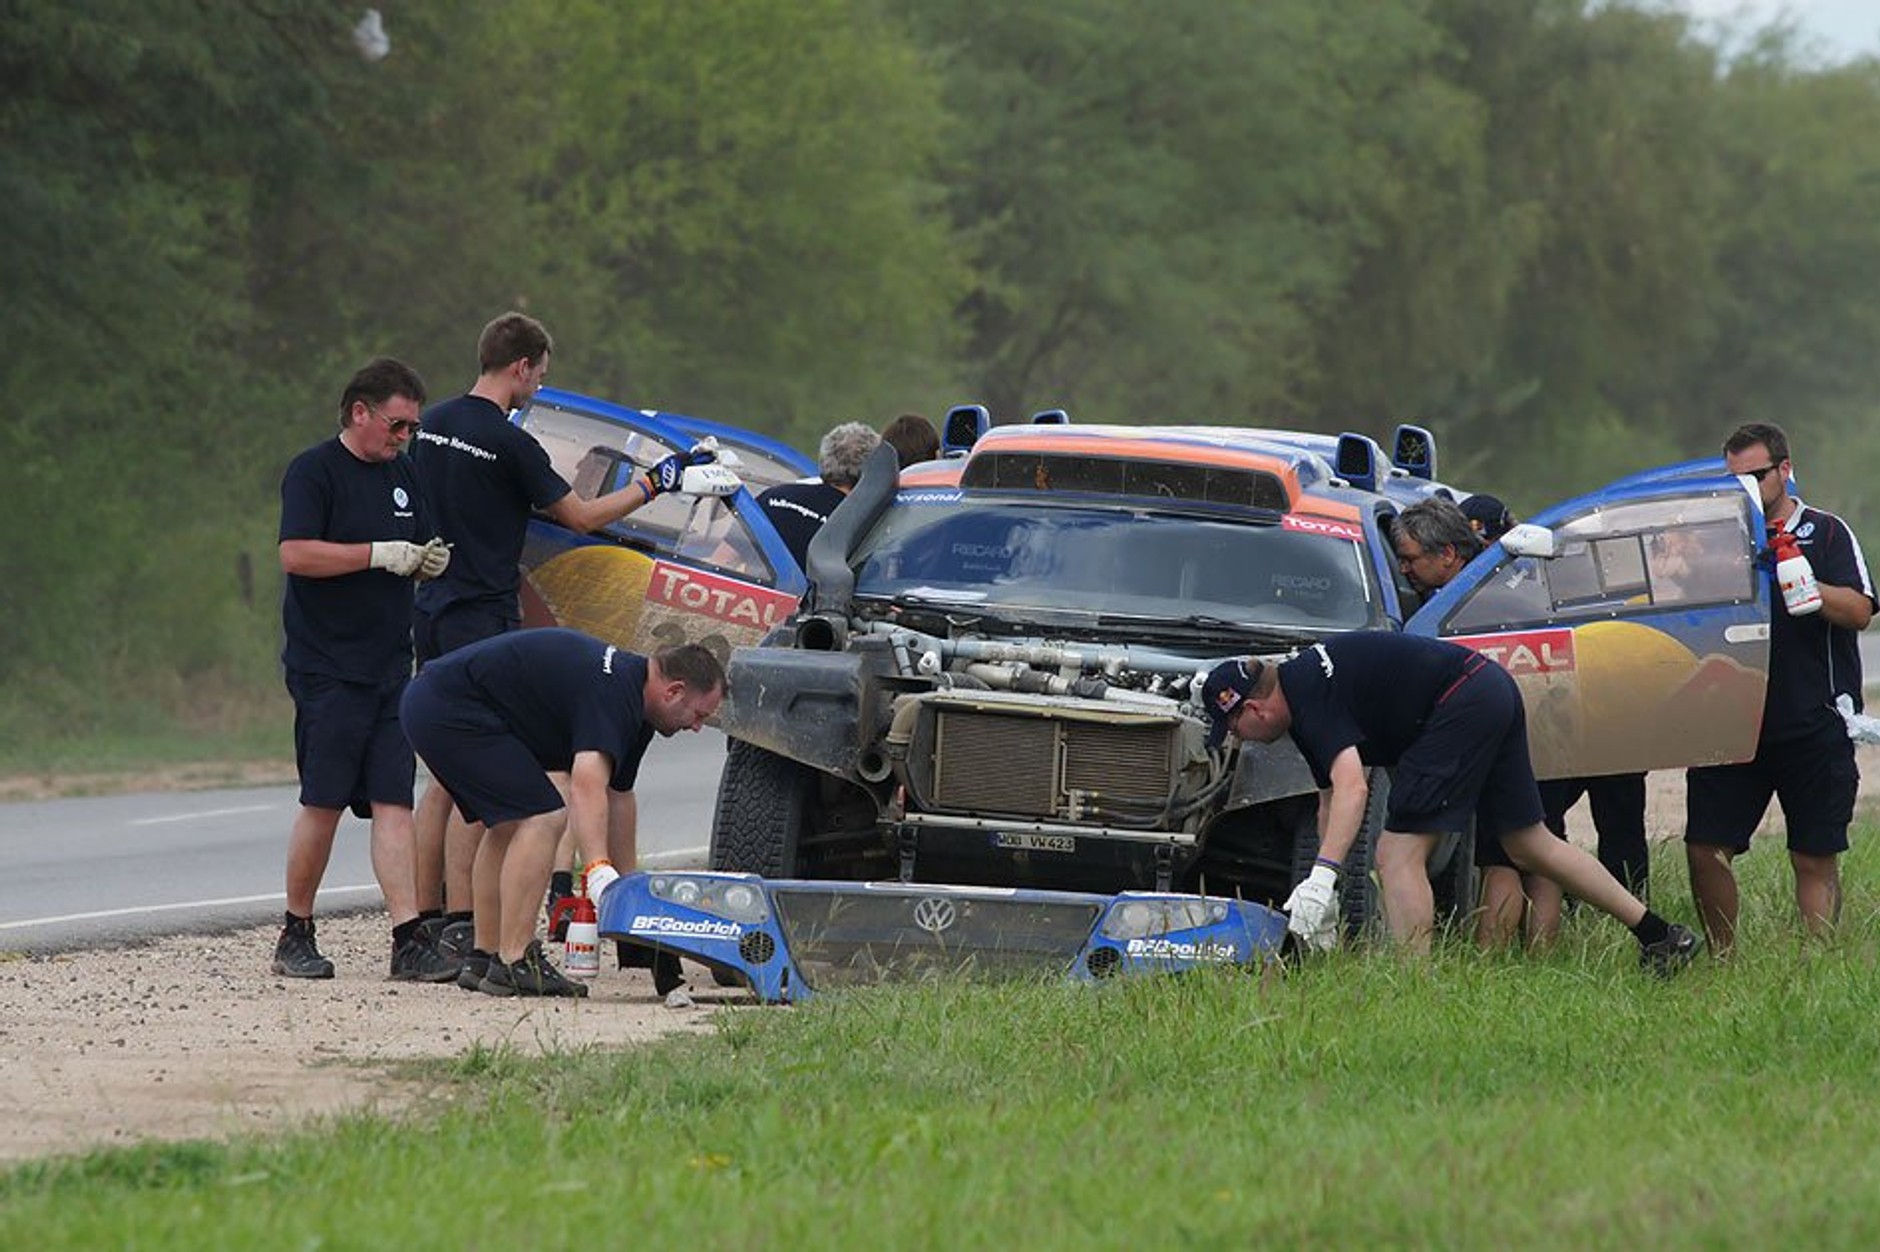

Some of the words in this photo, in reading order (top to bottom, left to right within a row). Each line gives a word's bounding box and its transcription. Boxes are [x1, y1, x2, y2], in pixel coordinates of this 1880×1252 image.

[1284, 514, 1362, 537] TOTAL
[952, 543, 1012, 558] RECARO
[1271, 573, 1331, 590] RECARO
[1479, 642, 1569, 670] TAL
[1048, 838, 1074, 850] 423
[631, 915, 742, 936] BFGoodrich
